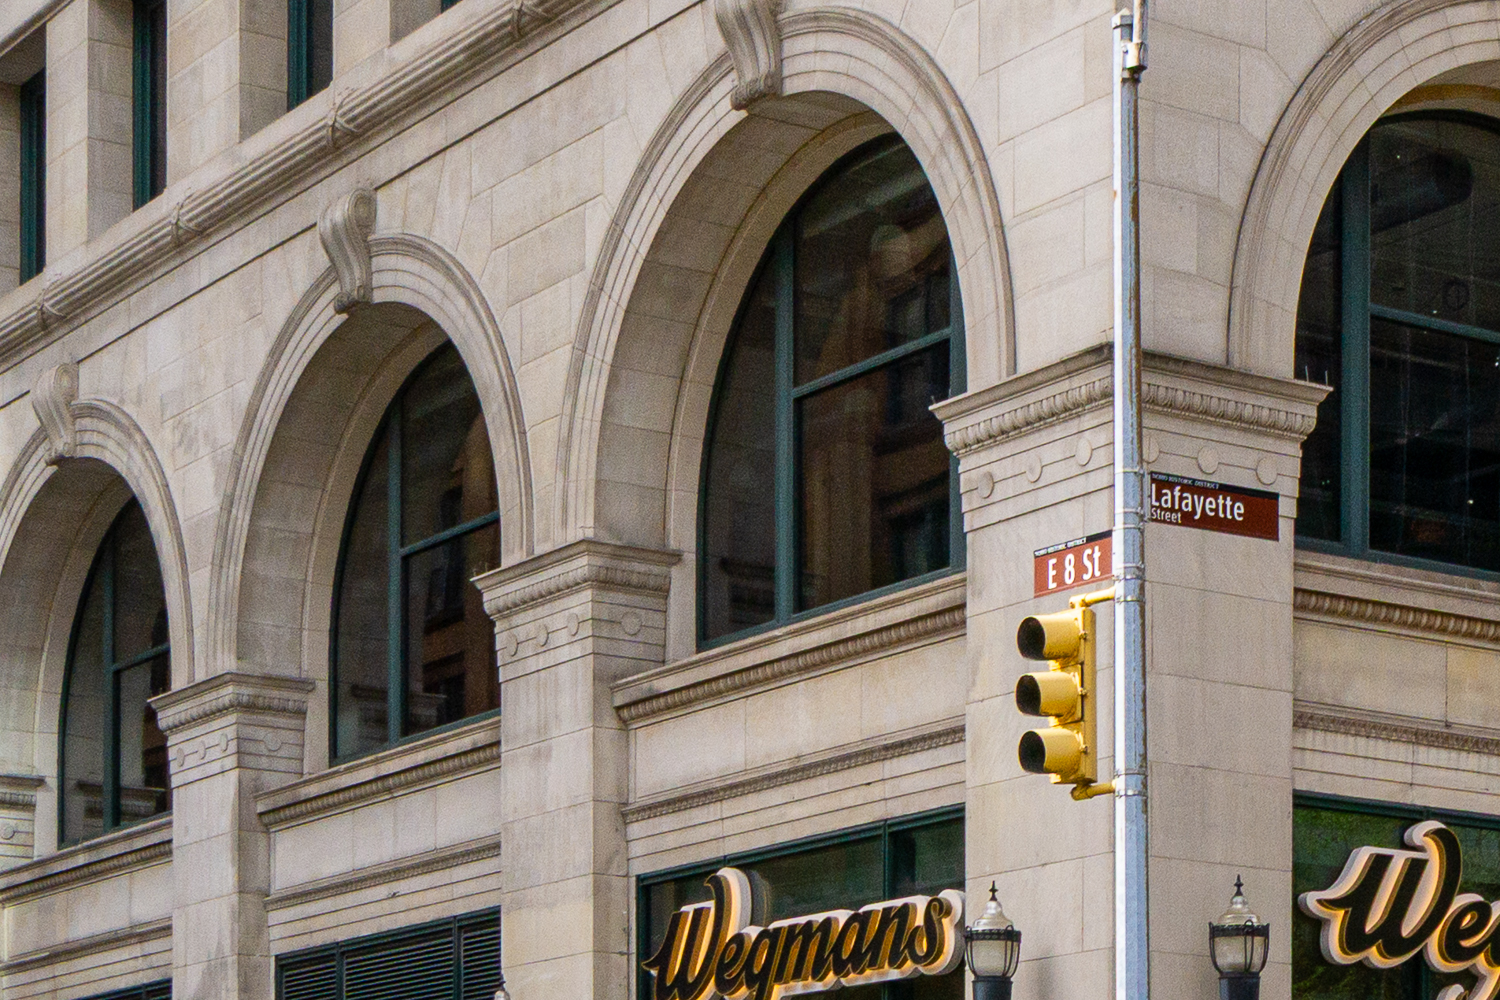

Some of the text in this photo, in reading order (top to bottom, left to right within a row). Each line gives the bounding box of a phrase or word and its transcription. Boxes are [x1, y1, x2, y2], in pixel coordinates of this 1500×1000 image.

[1151, 483, 1245, 521] Lafayette
[1151, 508, 1182, 524] Street
[1047, 545, 1102, 590] E 8 St
